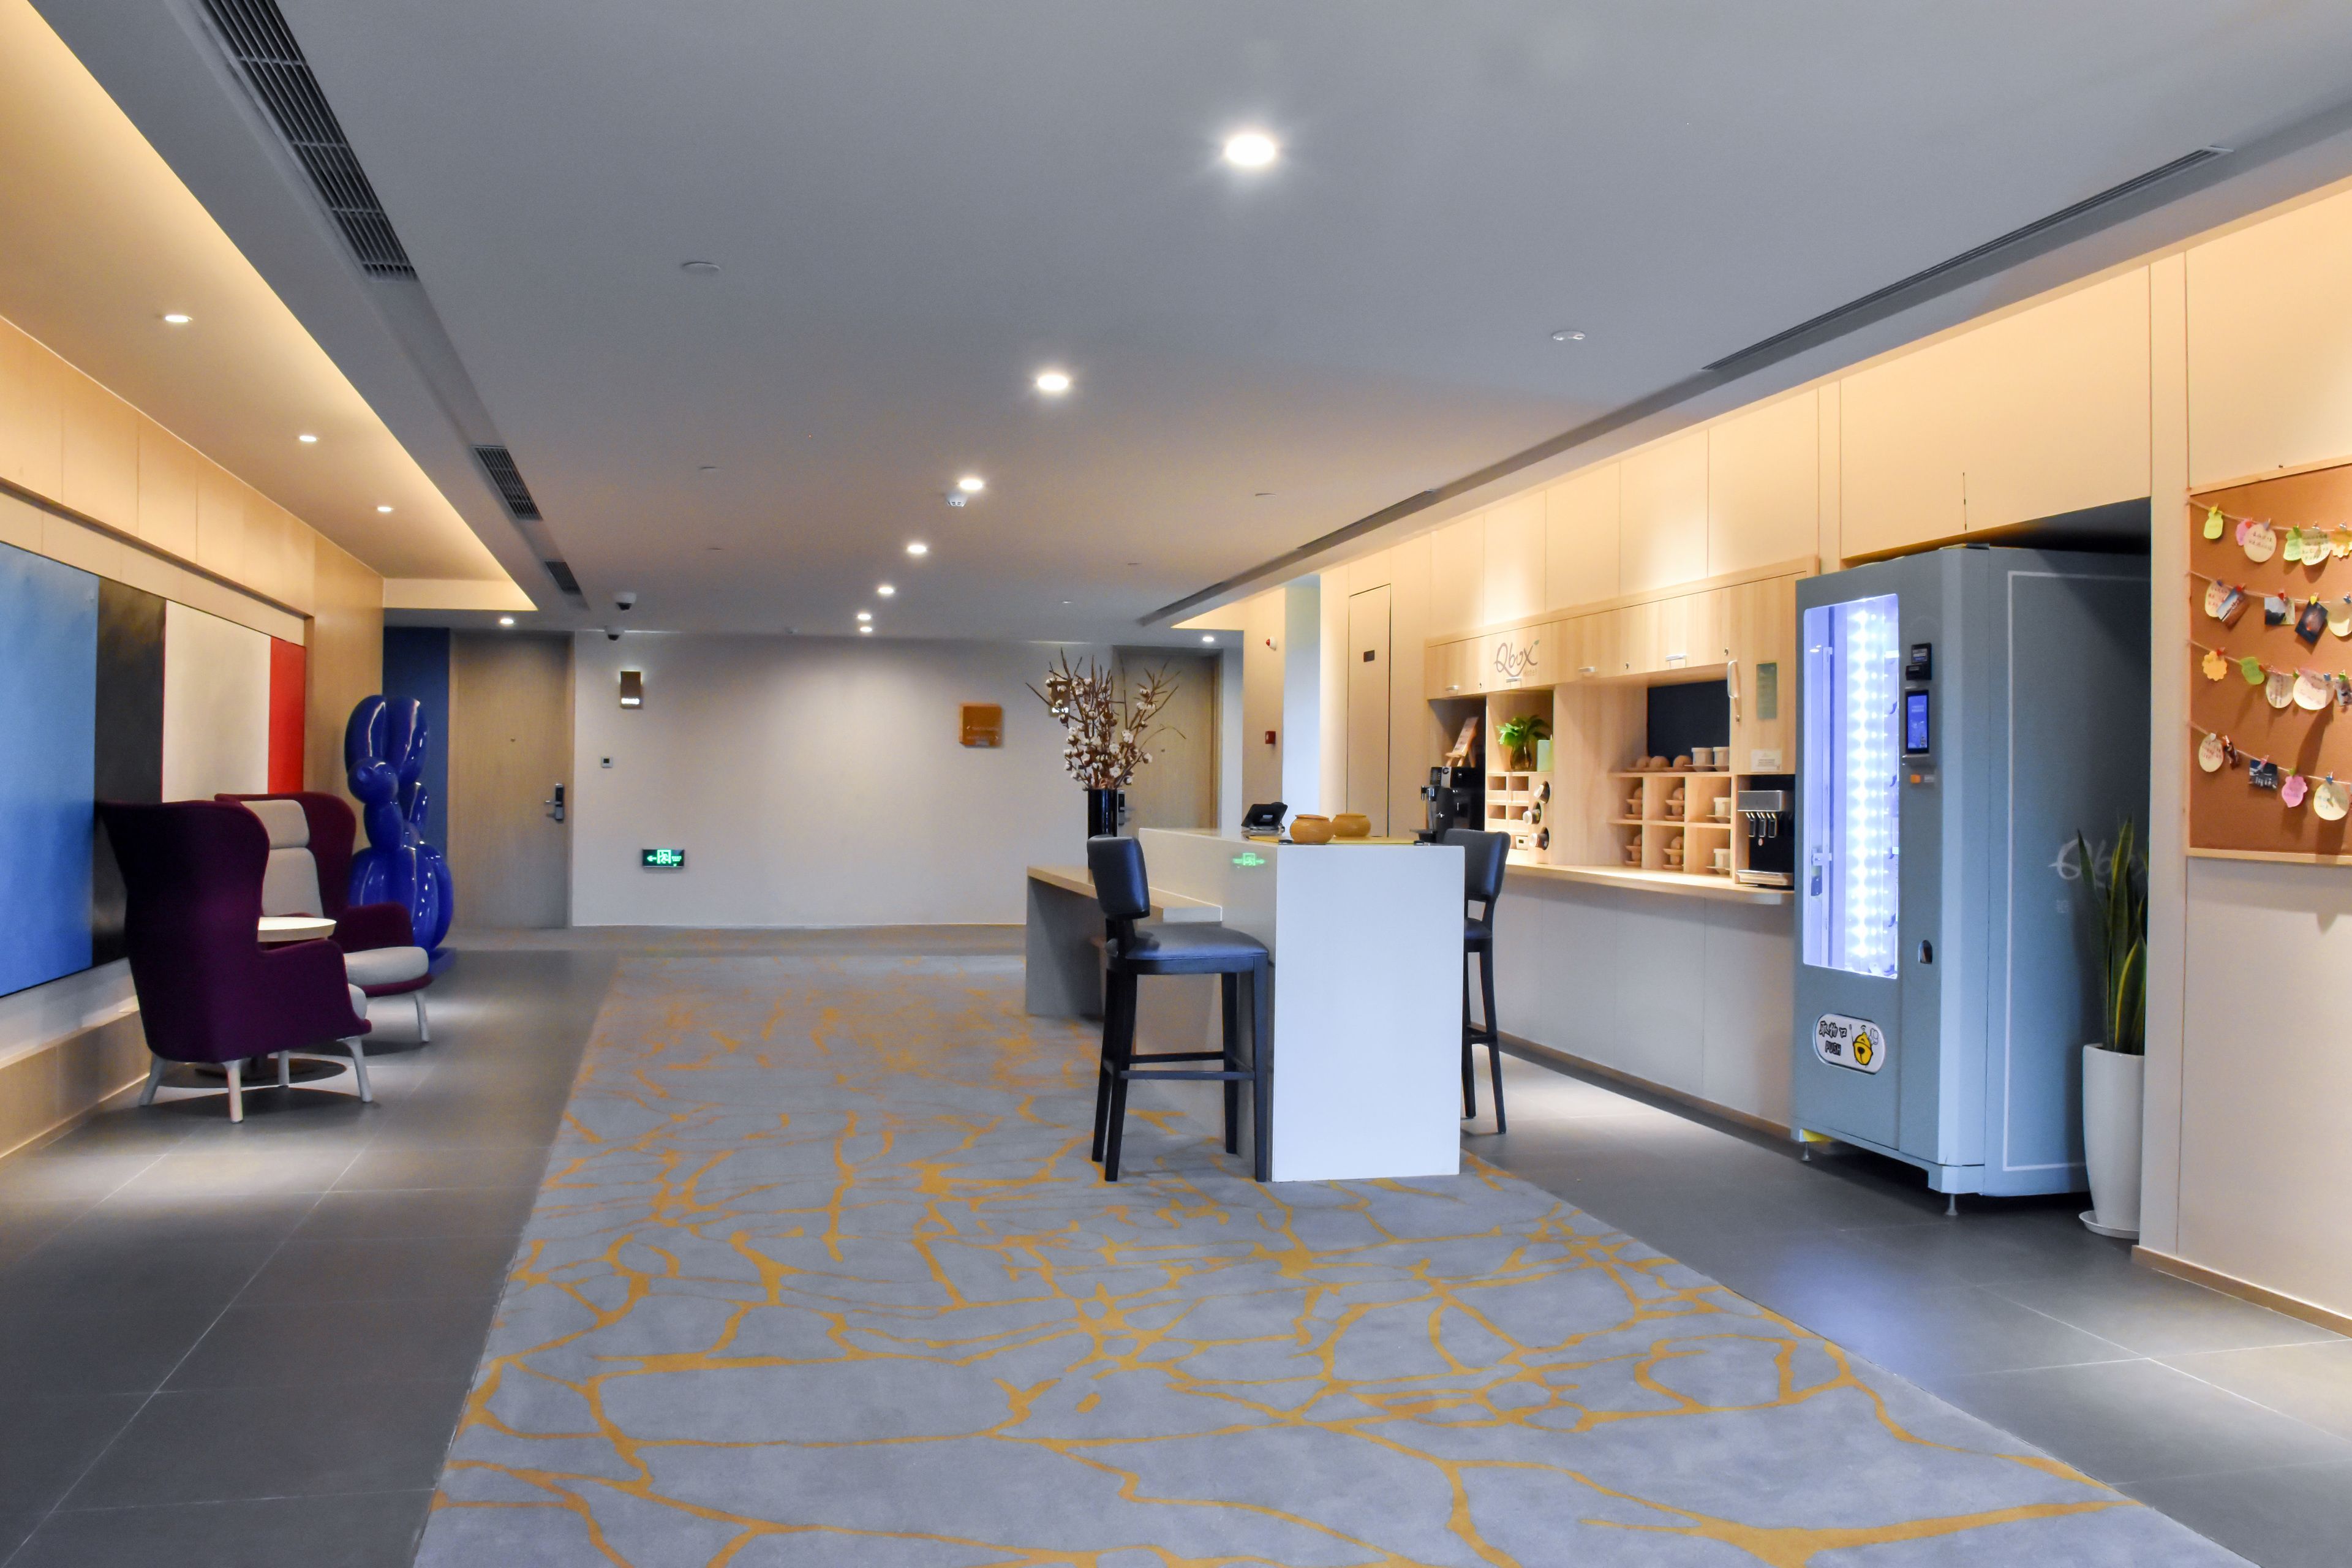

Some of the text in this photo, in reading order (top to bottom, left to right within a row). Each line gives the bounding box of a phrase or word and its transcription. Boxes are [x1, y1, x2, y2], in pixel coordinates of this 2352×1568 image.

[1819, 1020, 1847, 1038] 取物口
[1825, 1040, 1841, 1056] PUSH
